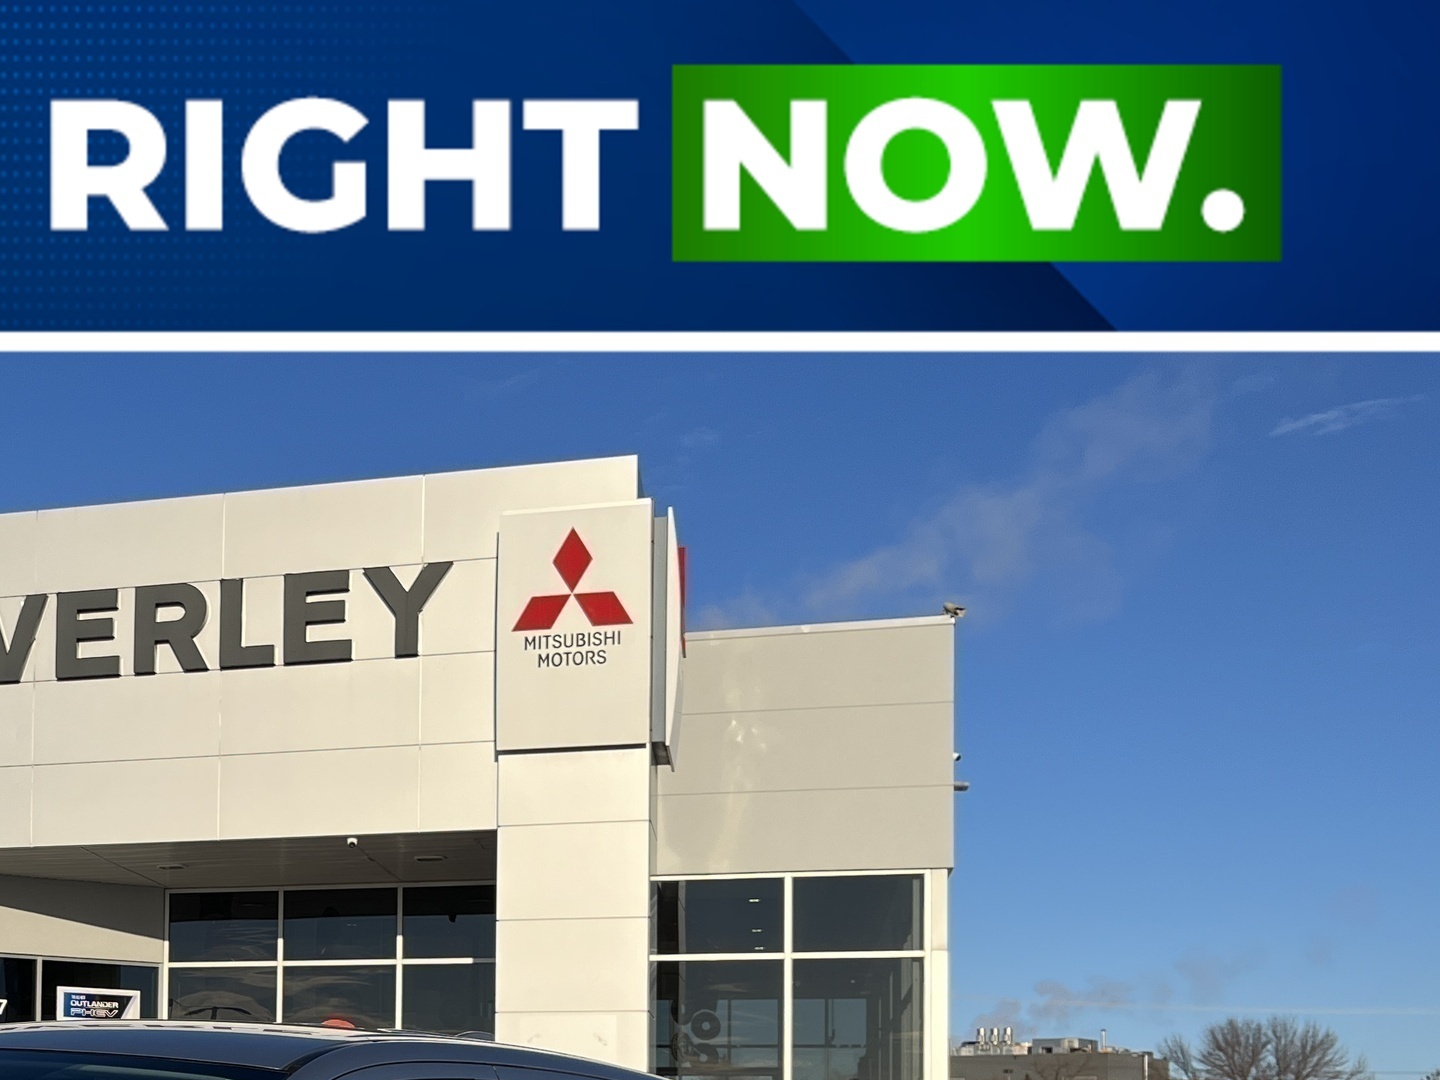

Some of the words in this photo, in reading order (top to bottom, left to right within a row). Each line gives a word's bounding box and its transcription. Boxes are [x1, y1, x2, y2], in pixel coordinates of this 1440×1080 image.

[524, 631, 621, 651] MITSUBISHI
[537, 650, 607, 668] MOTORS
[70, 1000, 119, 1008] OUTLANDER
[70, 1008, 118, 1017] PHEV
